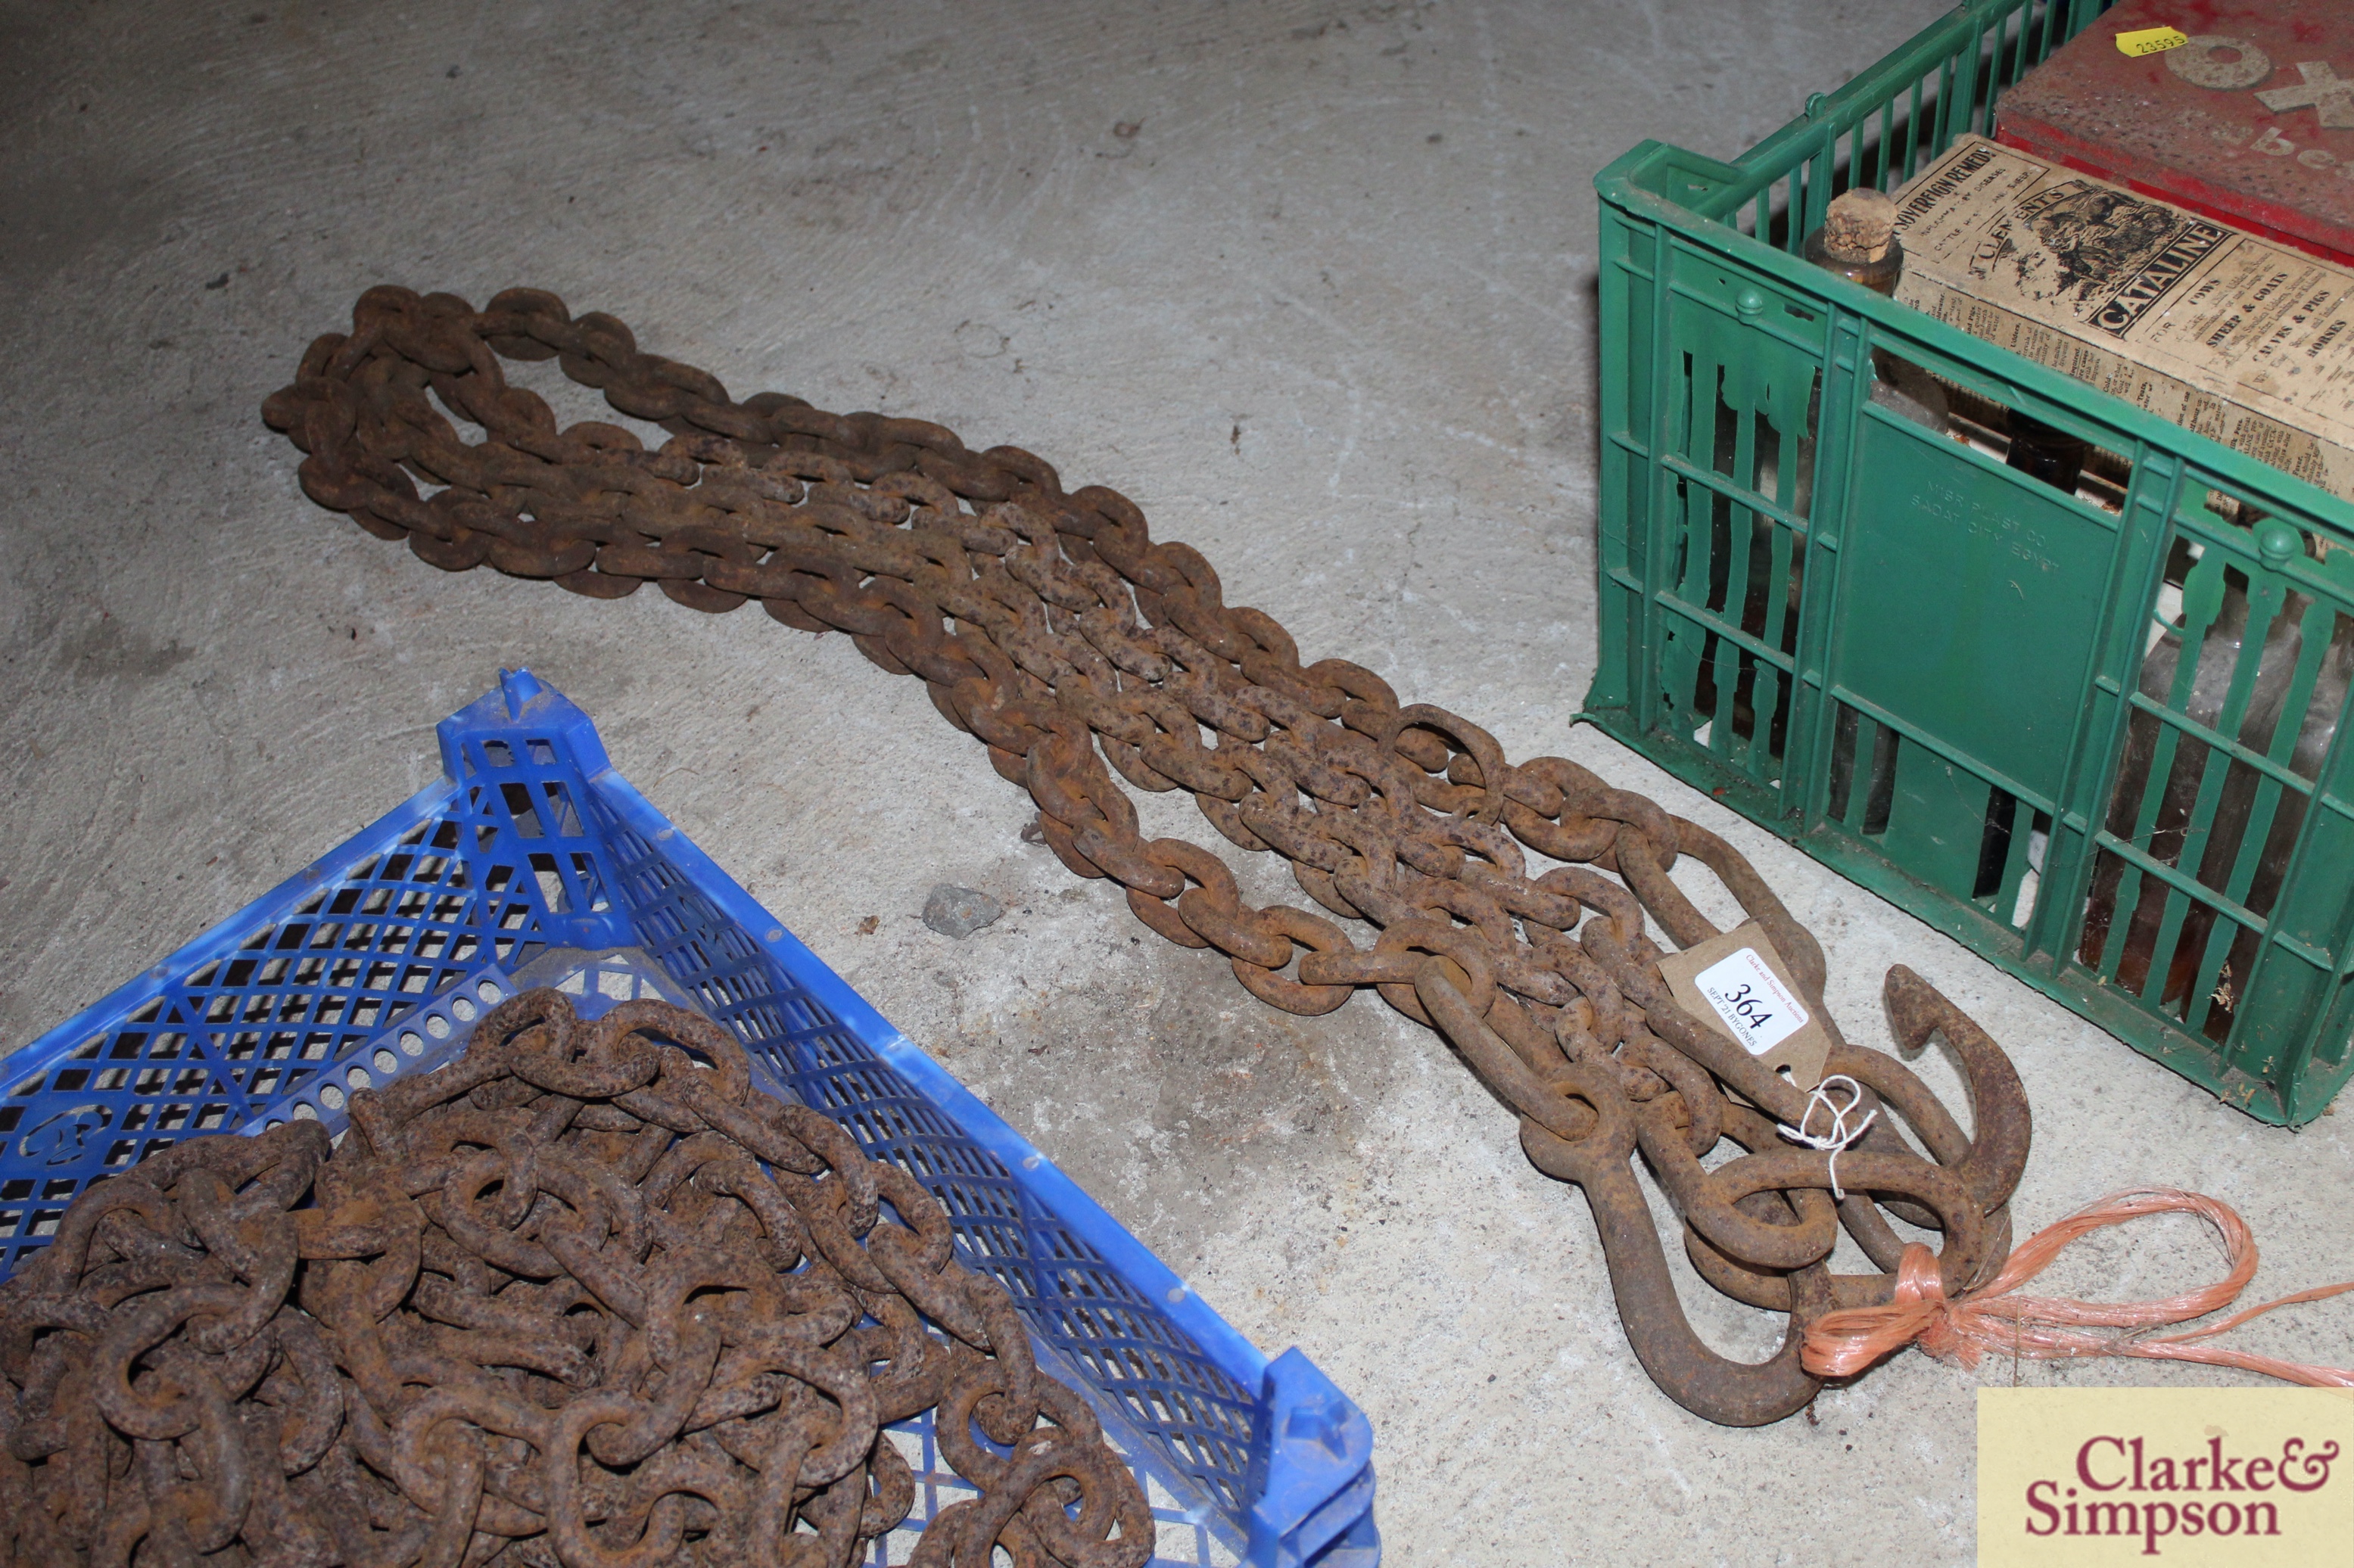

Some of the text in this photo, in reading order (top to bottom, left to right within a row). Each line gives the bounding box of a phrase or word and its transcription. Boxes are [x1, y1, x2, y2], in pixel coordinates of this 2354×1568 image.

[2136, 36, 2185, 54] 23595
[2096, 224, 2222, 330] CATALINE
[2206, 315, 2240, 347] SHEEP
[2241, 303, 2255, 313] &
[2253, 273, 2287, 300] GOATS
[2242, 312, 2268, 333] Swollen
[2284, 275, 2305, 291] Scour
[2302, 266, 2315, 277] and
[2292, 315, 2306, 323] &
[2302, 291, 2329, 312] PIGS
[1967, 305, 1976, 321] Pigs.
[1974, 306, 1984, 328] quarter
[1988, 310, 1994, 319] be
[2258, 321, 2274, 334] after
[2269, 298, 2299, 321] Lambing
[2310, 317, 2324, 329] and
[2026, 325, 2032, 334] of
[2030, 328, 2038, 350] restore
[2150, 322, 2175, 342] FOR
[2309, 321, 2346, 356] HORSES
[2054, 338, 2063, 359] milked
[2058, 341, 2069, 367] frequent
[2113, 362, 2122, 378] what
[2181, 403, 2187, 411] of
[2191, 407, 2200, 424] hour
[2243, 416, 2251, 433] great
[2250, 419, 2258, 432] pre-
[2259, 425, 2271, 450] avoiding
[2266, 428, 2277, 448] CATA-
[2276, 430, 2284, 443] with
[2278, 432, 2291, 463] days after
[2292, 456, 2303, 476] Fever.
[2301, 452, 2312, 472] should
[1926, 481, 1964, 507] MISR
[1970, 502, 2020, 533] PLAST
[1968, 521, 2003, 544] CITY
[2010, 541, 2060, 574] EGYPT
[1745, 954, 1804, 1023] Clarke and Simpson Auctions
[1707, 987, 1724, 1005] SEPT
[1727, 1013, 1758, 1047] BYGONES
[1724, 983, 1773, 1030] 364
